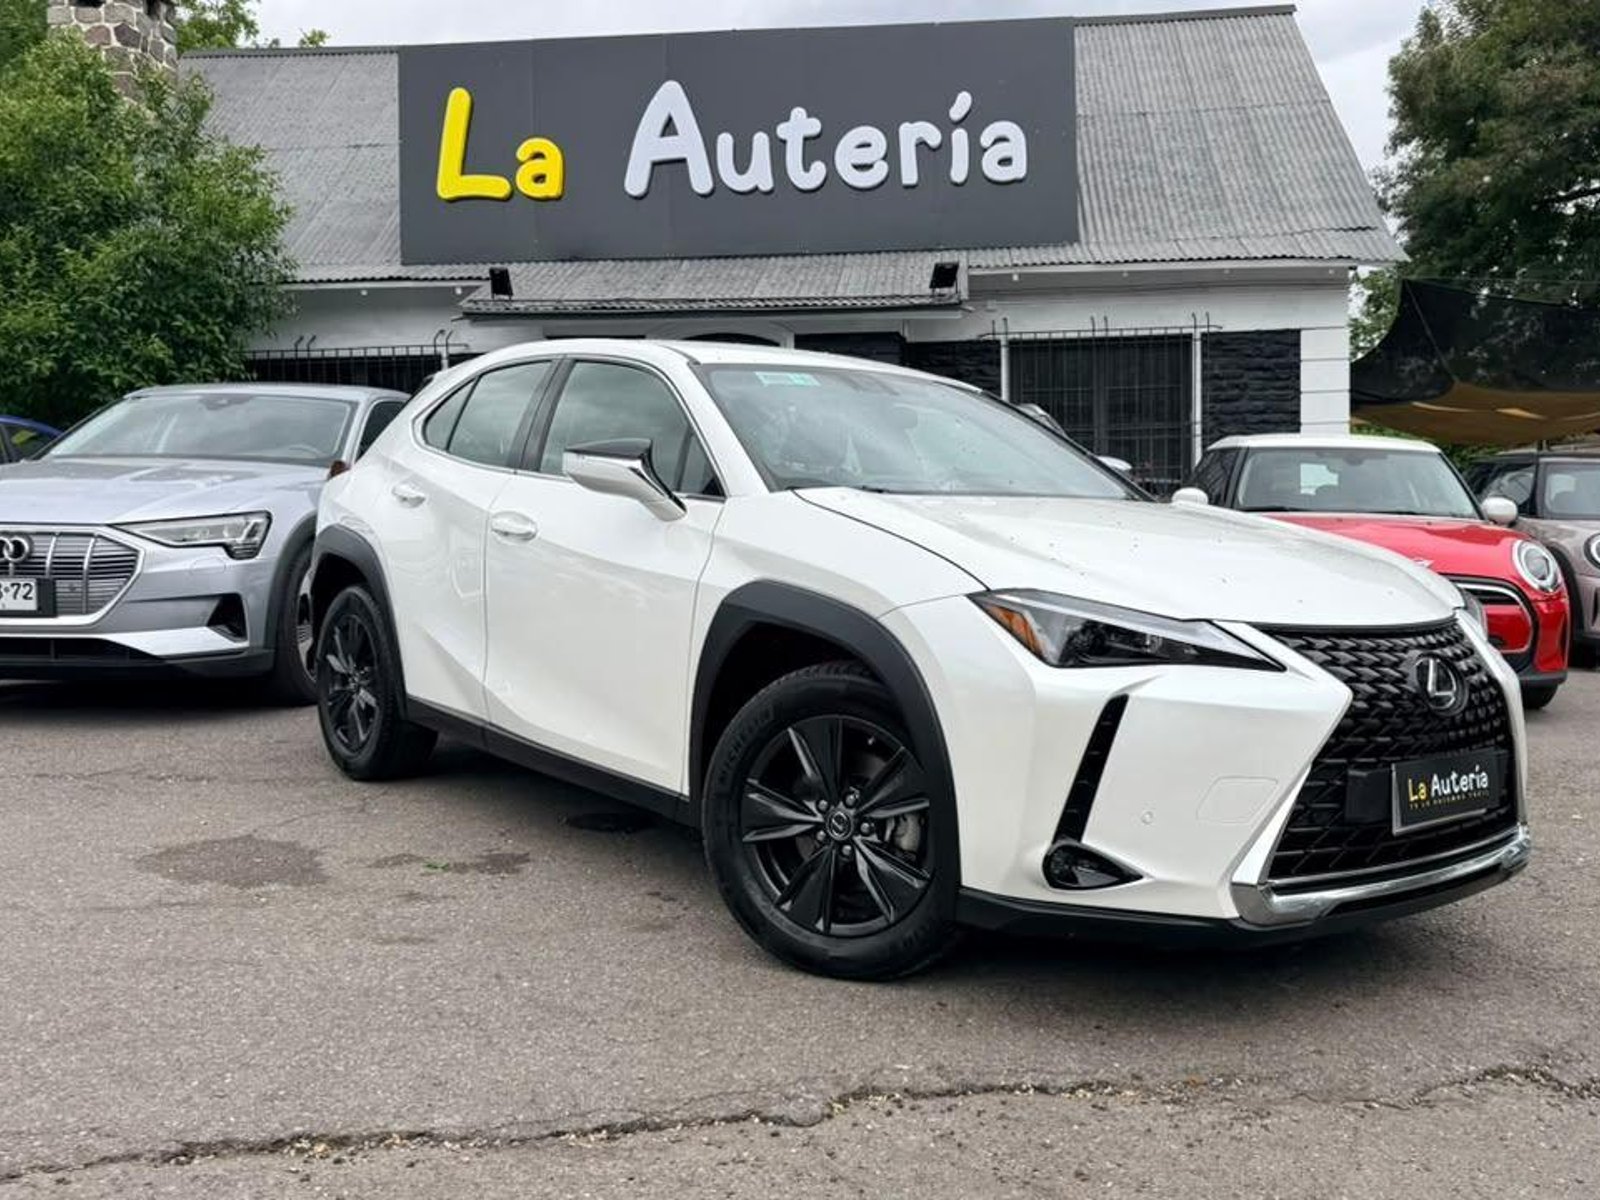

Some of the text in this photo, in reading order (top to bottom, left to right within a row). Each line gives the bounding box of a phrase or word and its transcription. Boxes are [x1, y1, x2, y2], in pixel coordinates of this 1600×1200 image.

[436, 79, 1029, 202] La Autería
[1408, 779, 1427, 802] La
[1430, 764, 1489, 797] Autería
